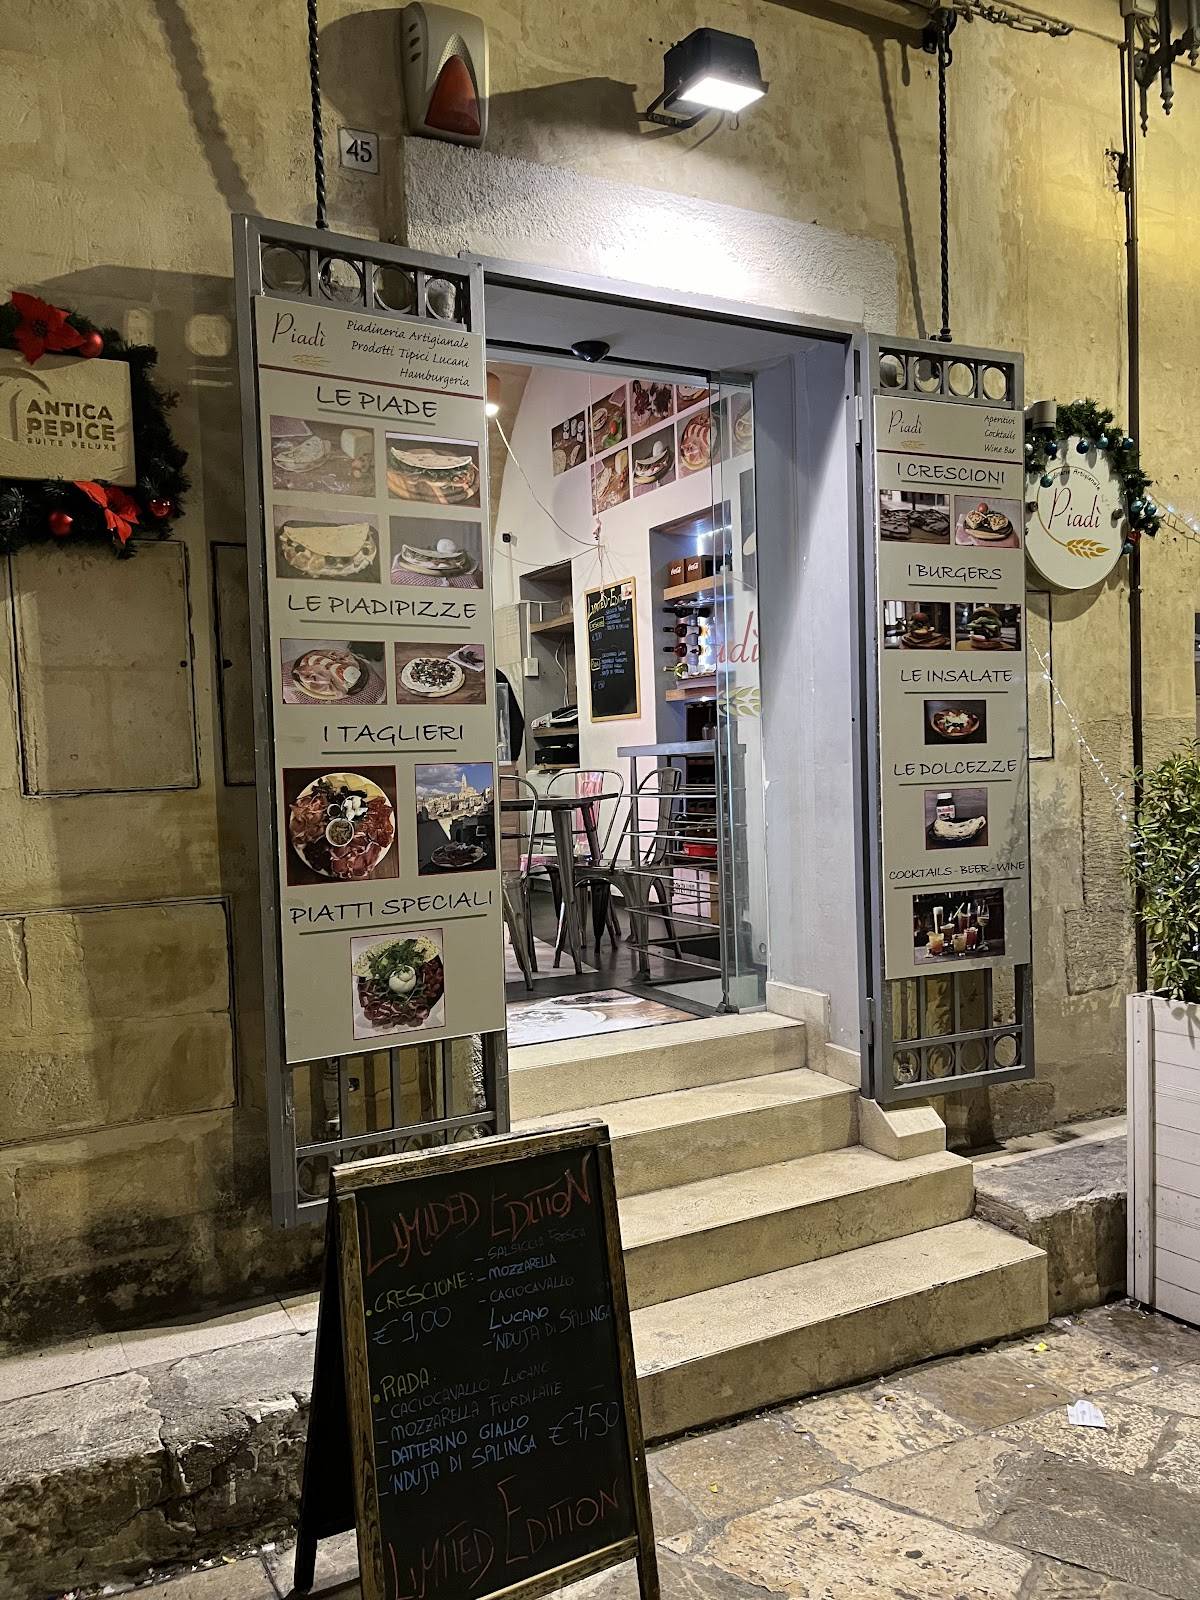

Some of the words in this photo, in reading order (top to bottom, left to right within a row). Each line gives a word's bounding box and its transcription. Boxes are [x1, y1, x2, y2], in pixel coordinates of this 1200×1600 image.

[346, 139, 373, 163] 45
[271, 311, 326, 348] Piadì
[346, 320, 406, 339] Piadineria
[408, 331, 469, 350] Artigianale
[351, 340, 395, 357] Prodotti
[399, 346, 430, 366] Tipici
[432, 353, 470, 368] Lucani
[400, 367, 470, 389] Hamburgeria
[27, 398, 113, 421] ANTICA
[316, 386, 351, 406] LE
[358, 391, 438, 418] PIADE
[26, 417, 116, 441] PEPICE
[888, 409, 923, 435] Piadì
[984, 429, 1016, 440] Cocktails
[71, 440, 117, 452] DELUXE
[984, 443, 1002, 453] Wine
[1004, 445, 1017, 454] Bar
[907, 463, 1005, 484] CRESCIONI
[1047, 487, 1102, 530] Piadì
[916, 564, 1002, 582] BURGERS
[288, 594, 321, 613] LE
[328, 596, 477, 619] PIADIPIZZE
[900, 669, 922, 683] LE
[927, 669, 1013, 683] INSALATE
[337, 724, 464, 746] TAGLIERI
[893, 763, 916, 776] LE
[920, 759, 1017, 776] DOLCEZZE
[889, 866, 953, 880] COCKTAILS
[960, 864, 989, 875] BEER
[997, 861, 1025, 873] WINE
[289, 901, 374, 924] PIATTI
[381, 890, 493, 915] SPECIALI
[488, 1253, 558, 1280] MOZZARELLA
[489, 1275, 577, 1303] CACIOCAVALLO
[400, 1306, 452, 1343] 9,00
[488, 1306, 550, 1331] LUCANO
[390, 1378, 490, 1419] CACIOCAVALLO
[391, 1400, 480, 1441] MOZZARELLA
[391, 1430, 468, 1468] DATTERINO
[479, 1415, 530, 1440] GIALLO
[449, 1454, 464, 1474] DI
[471, 1434, 538, 1471] SPILINGA
[496, 1474, 620, 1566] EDITION
